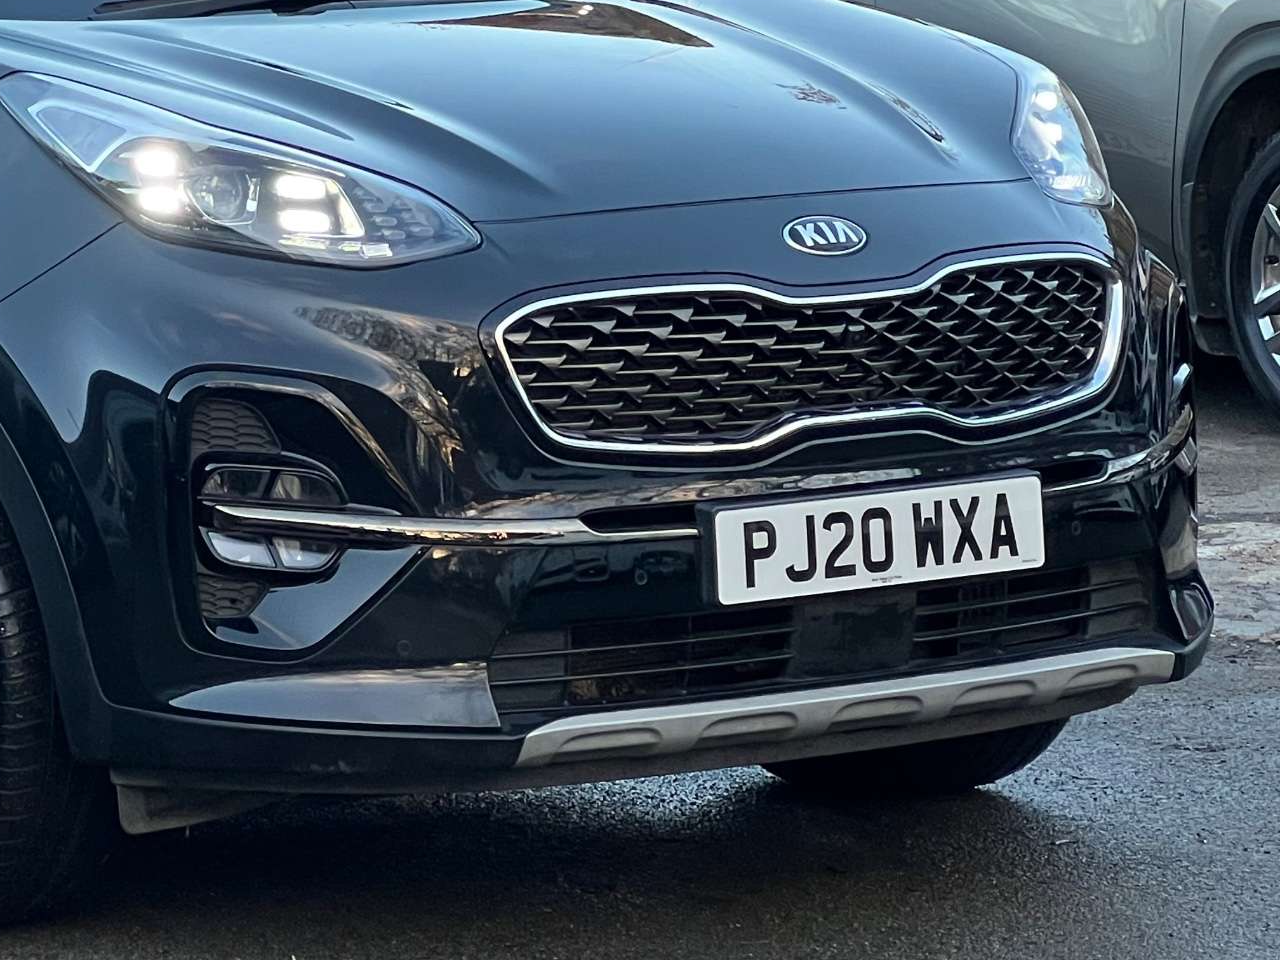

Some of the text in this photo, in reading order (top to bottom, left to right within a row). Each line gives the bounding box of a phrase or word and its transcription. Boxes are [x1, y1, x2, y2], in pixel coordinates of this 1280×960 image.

[793, 221, 859, 247] KIA
[743, 493, 1019, 589] PJ20 WXA
